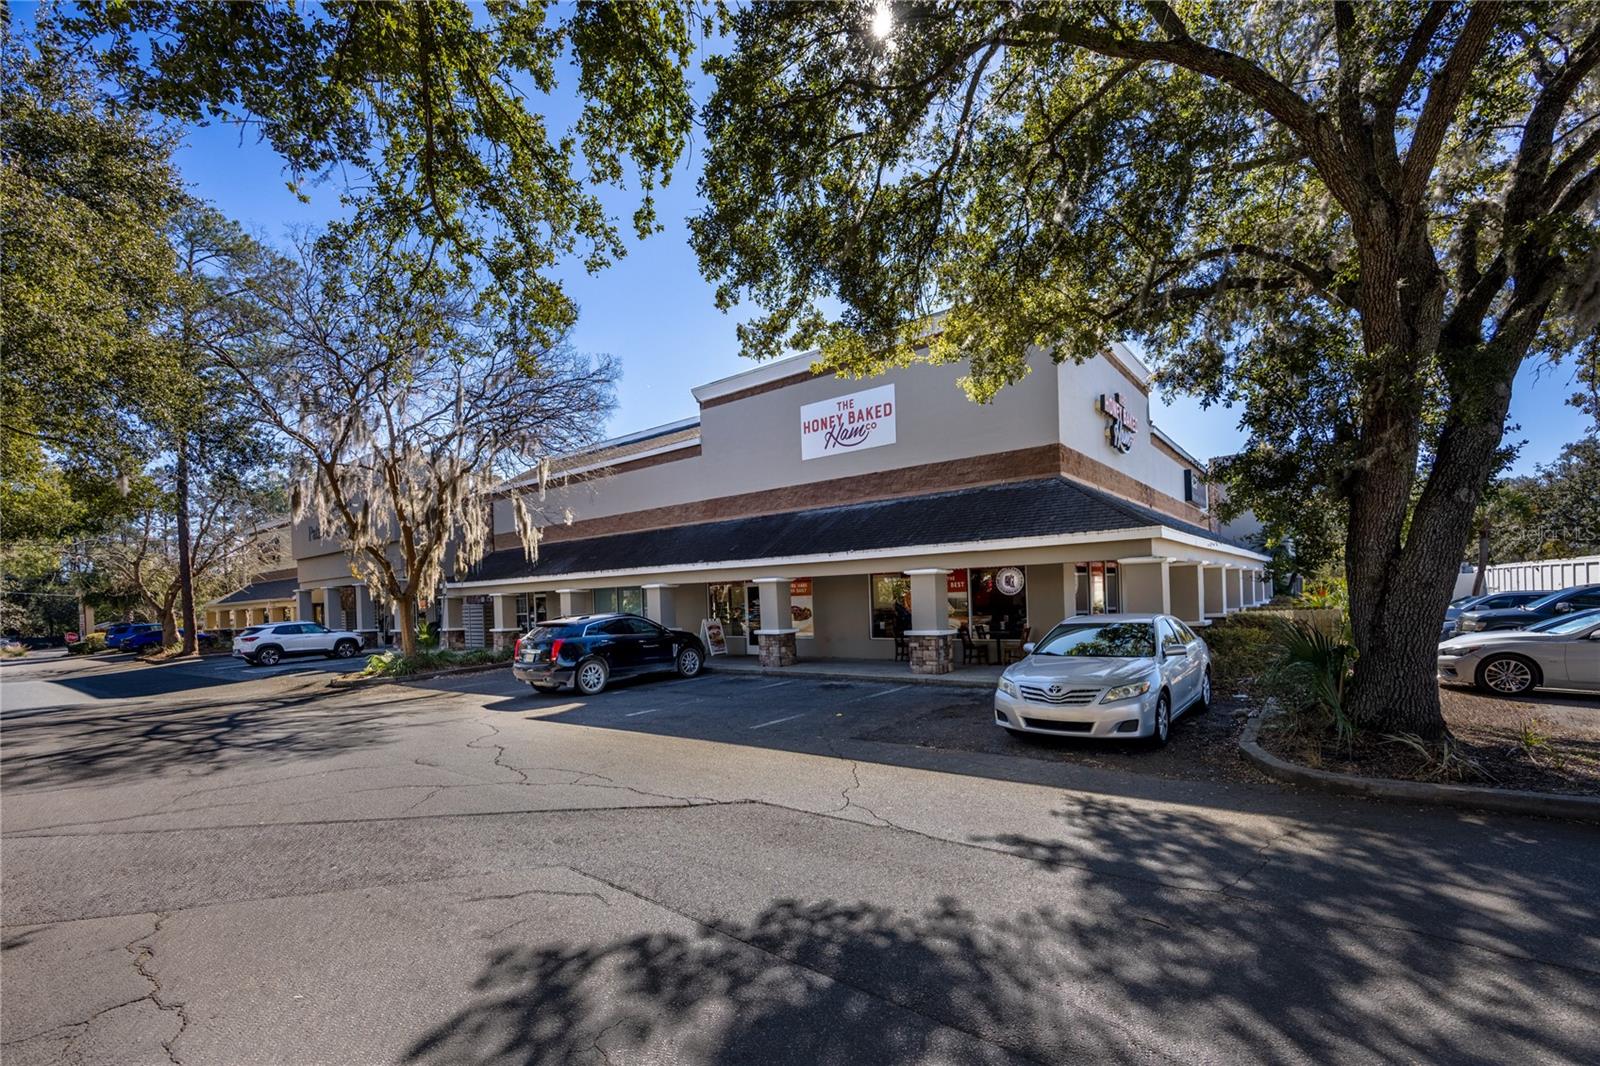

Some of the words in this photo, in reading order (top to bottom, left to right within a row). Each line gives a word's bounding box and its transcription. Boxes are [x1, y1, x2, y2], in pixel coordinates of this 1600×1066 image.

[803, 413, 844, 435] HONEY
[848, 402, 893, 425] BAKED
[837, 399, 854, 411] THE
[824, 422, 870, 449] Ham
